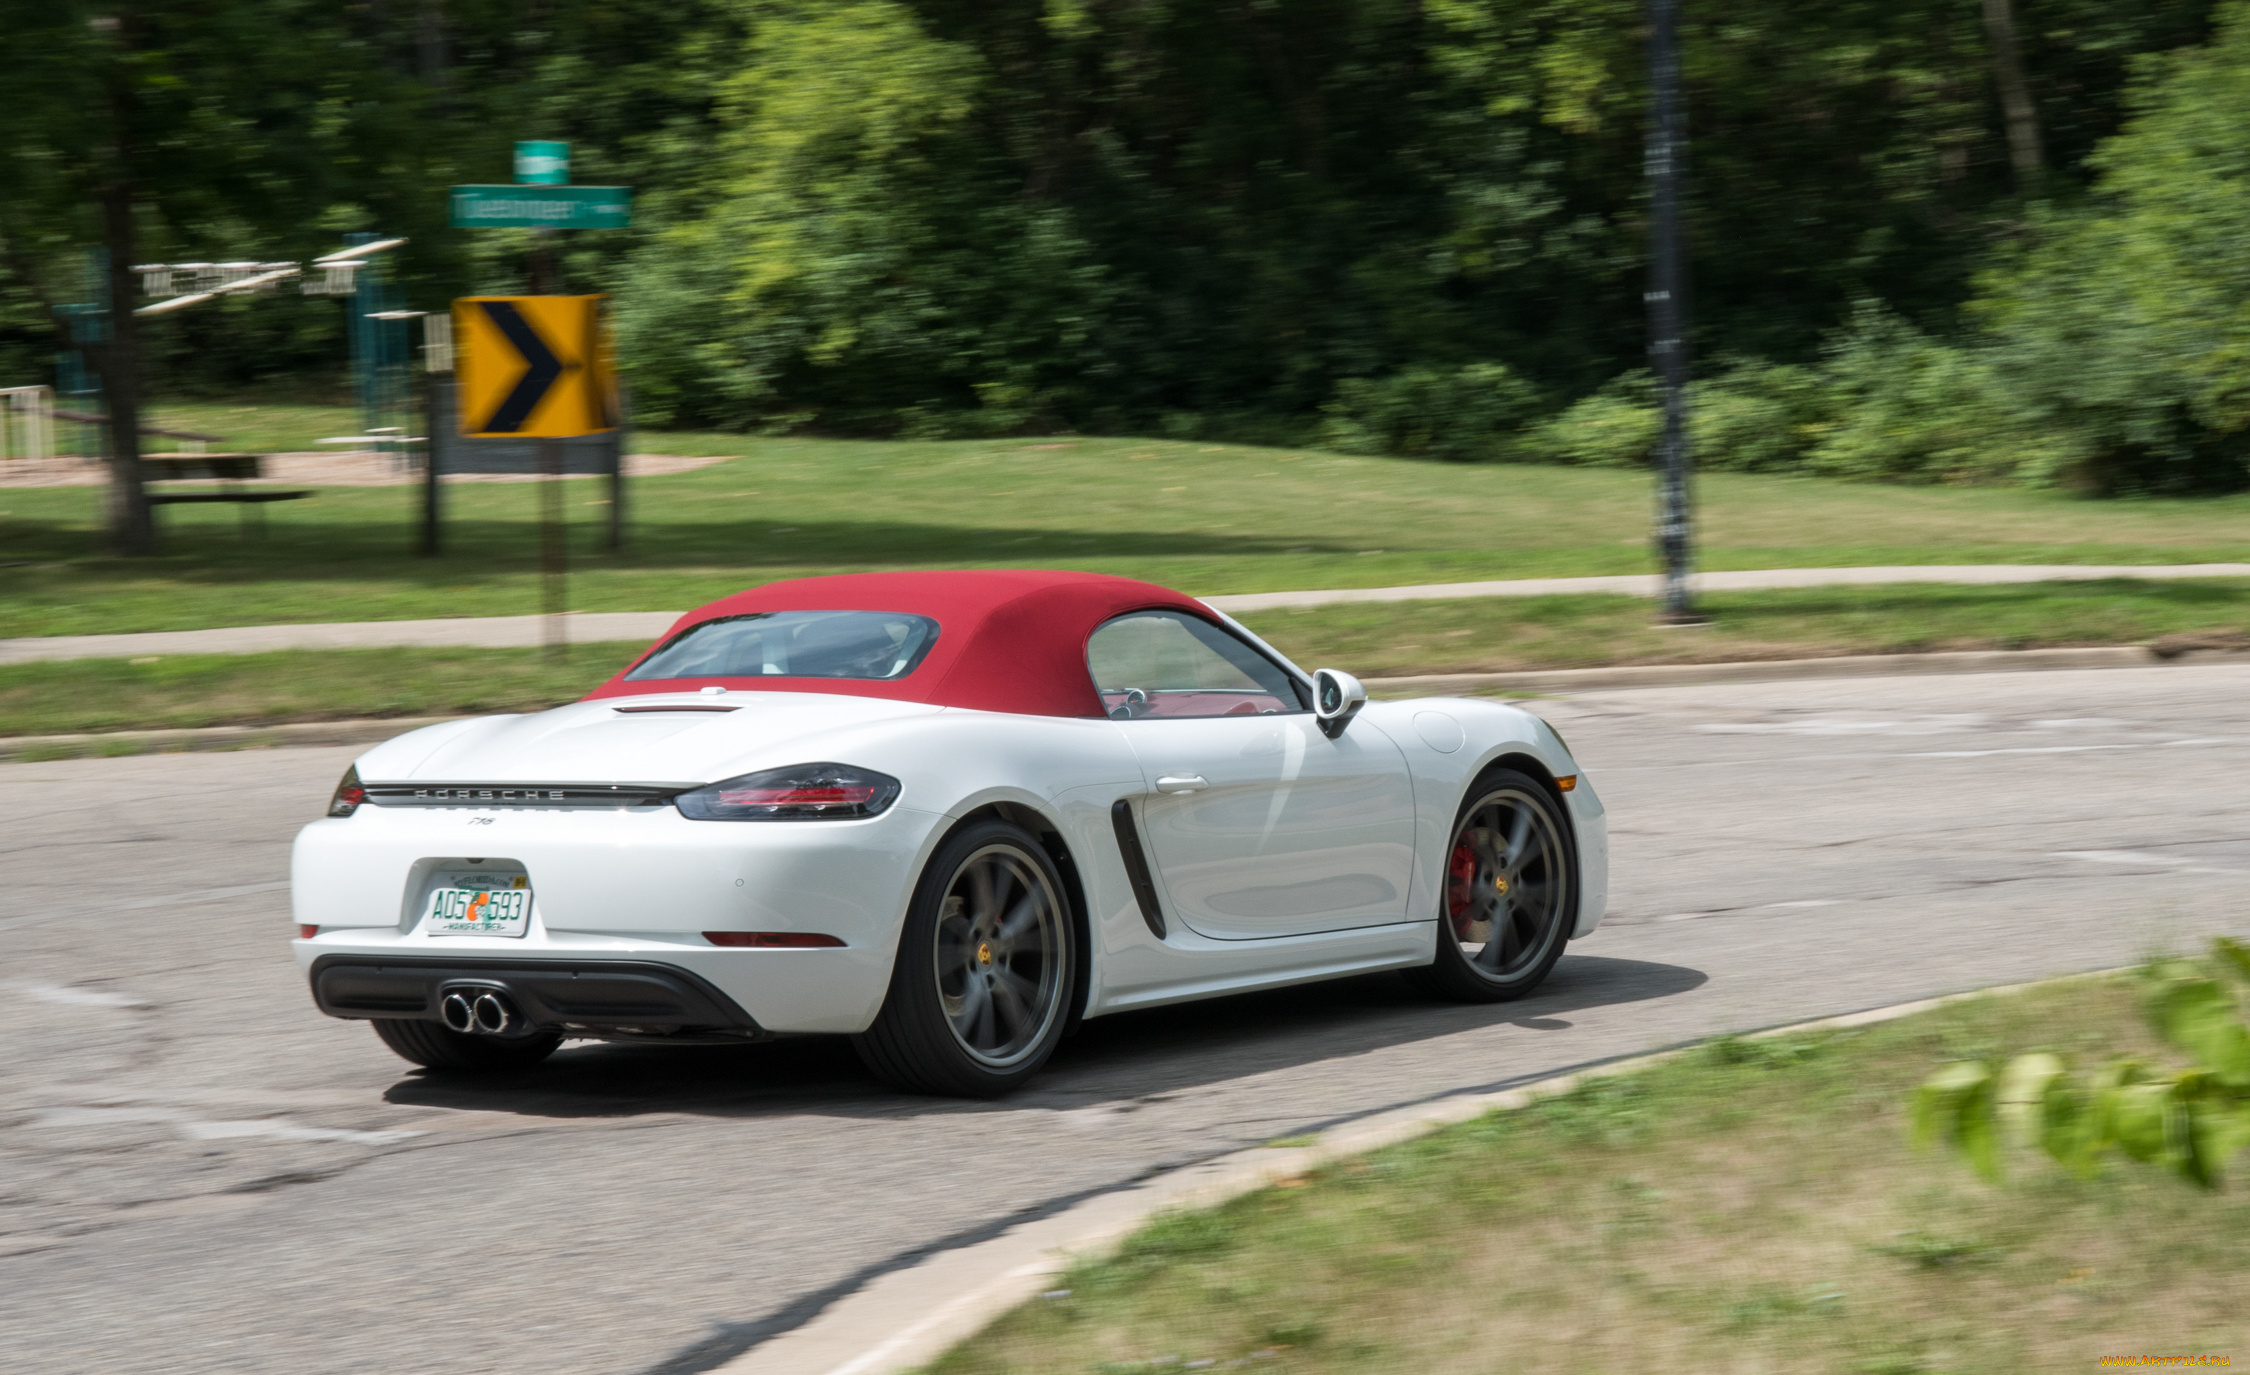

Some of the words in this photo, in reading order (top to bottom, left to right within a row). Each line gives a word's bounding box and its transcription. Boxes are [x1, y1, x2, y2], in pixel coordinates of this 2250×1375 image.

[414, 789, 564, 800] PORSCHE
[467, 817, 496, 826] 718
[487, 892, 522, 920] 593
